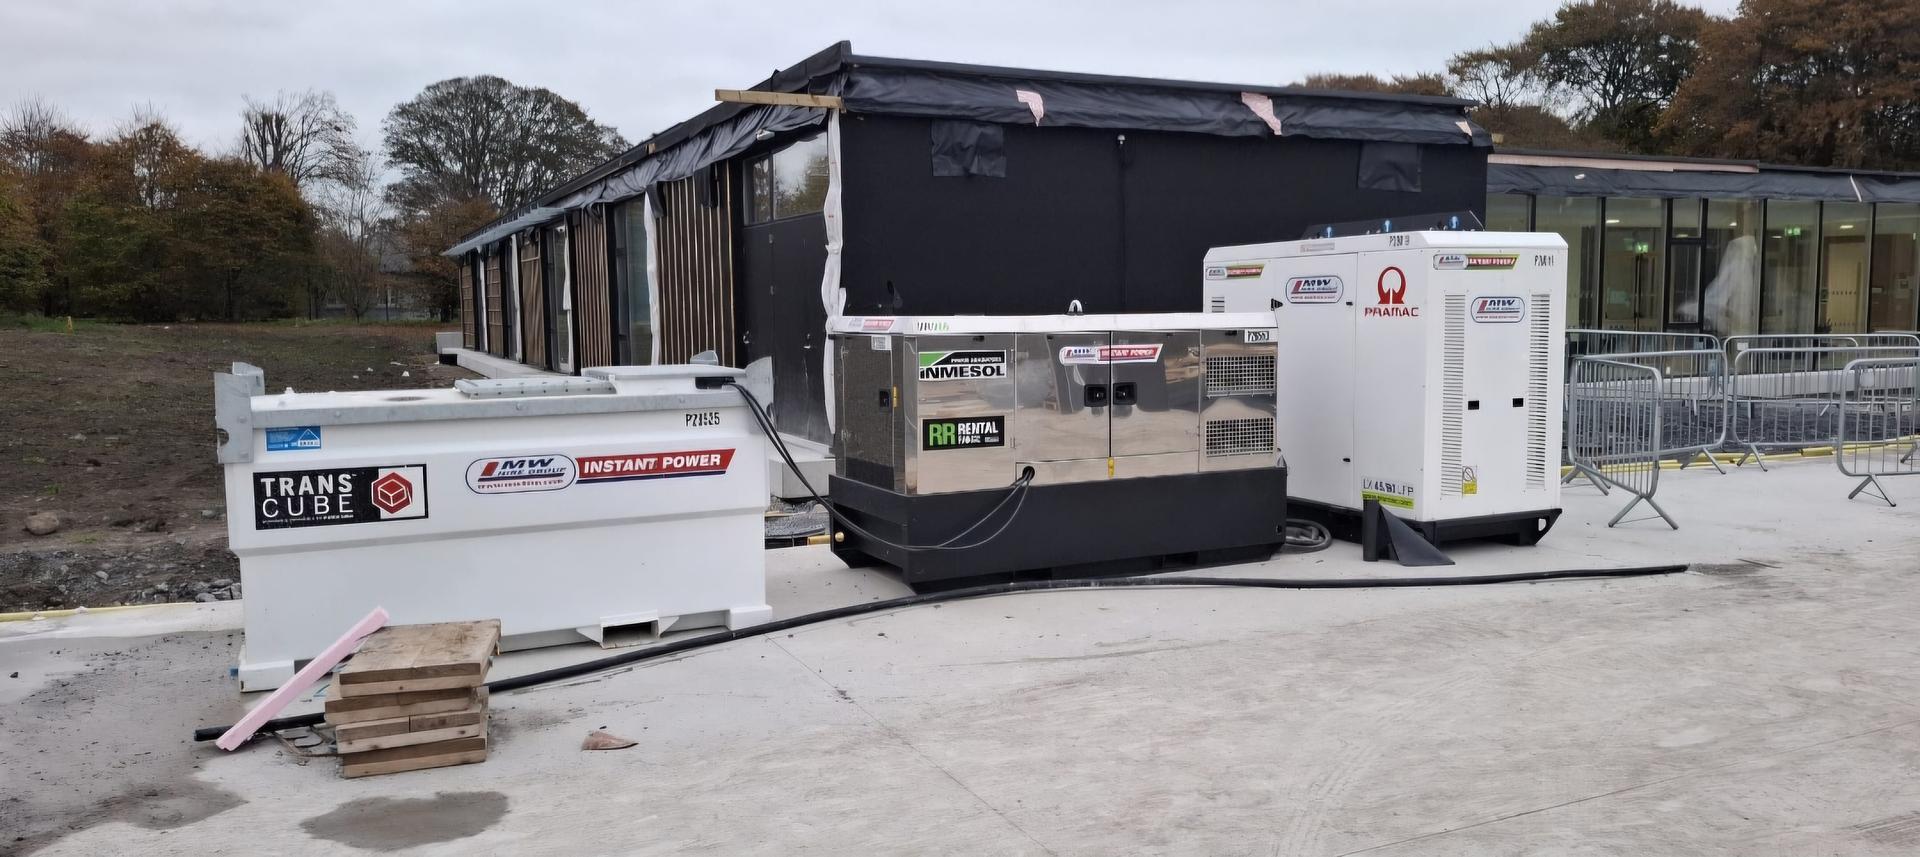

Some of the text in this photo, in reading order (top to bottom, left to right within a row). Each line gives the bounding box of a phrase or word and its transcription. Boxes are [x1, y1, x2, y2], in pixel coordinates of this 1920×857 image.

[1364, 307, 1419, 317] PRAMAC
[929, 422, 956, 446] RR
[958, 421, 999, 435] RENTAL
[501, 458, 553, 470] MW
[584, 453, 722, 474] INSTANT POWER
[260, 473, 353, 498] TRANS
[262, 493, 354, 518] CUBE
